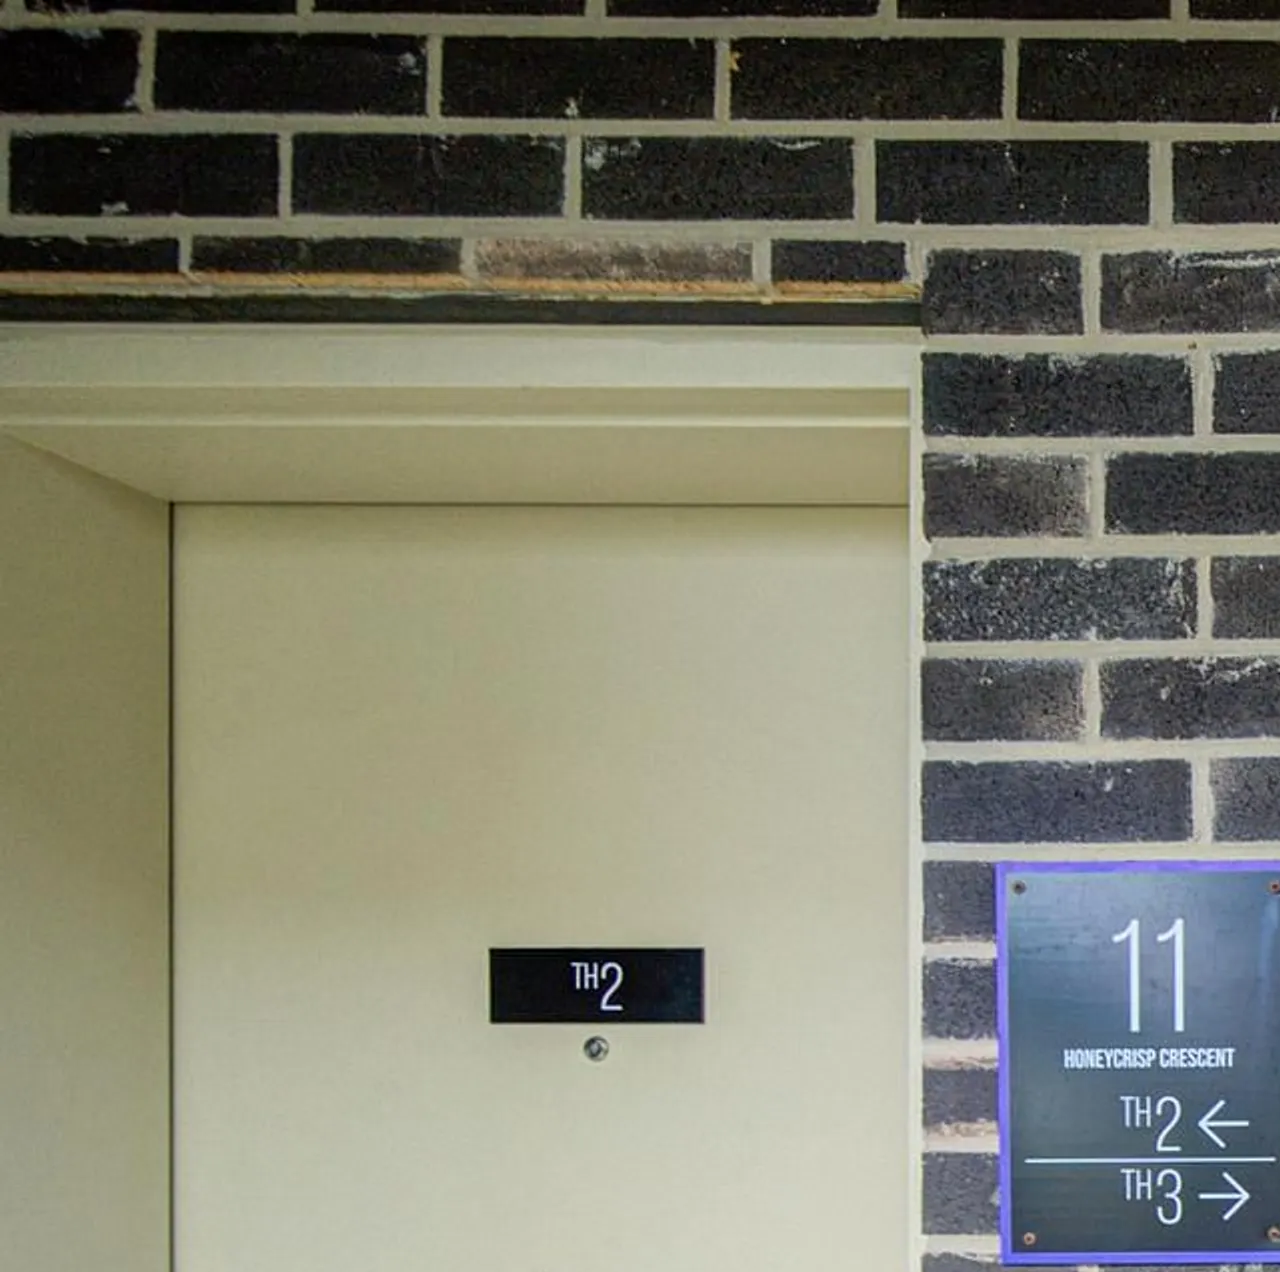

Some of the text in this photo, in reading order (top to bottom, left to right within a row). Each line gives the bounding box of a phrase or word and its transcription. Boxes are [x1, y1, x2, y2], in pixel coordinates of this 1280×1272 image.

[570, 961, 623, 1011] TH2
[1111, 917, 1185, 1032] 11
[1063, 1047, 1236, 1069] HONEYCRISP CRESCENT
[1119, 1096, 1183, 1151] TH2
[1120, 1168, 1183, 1225] TH3
